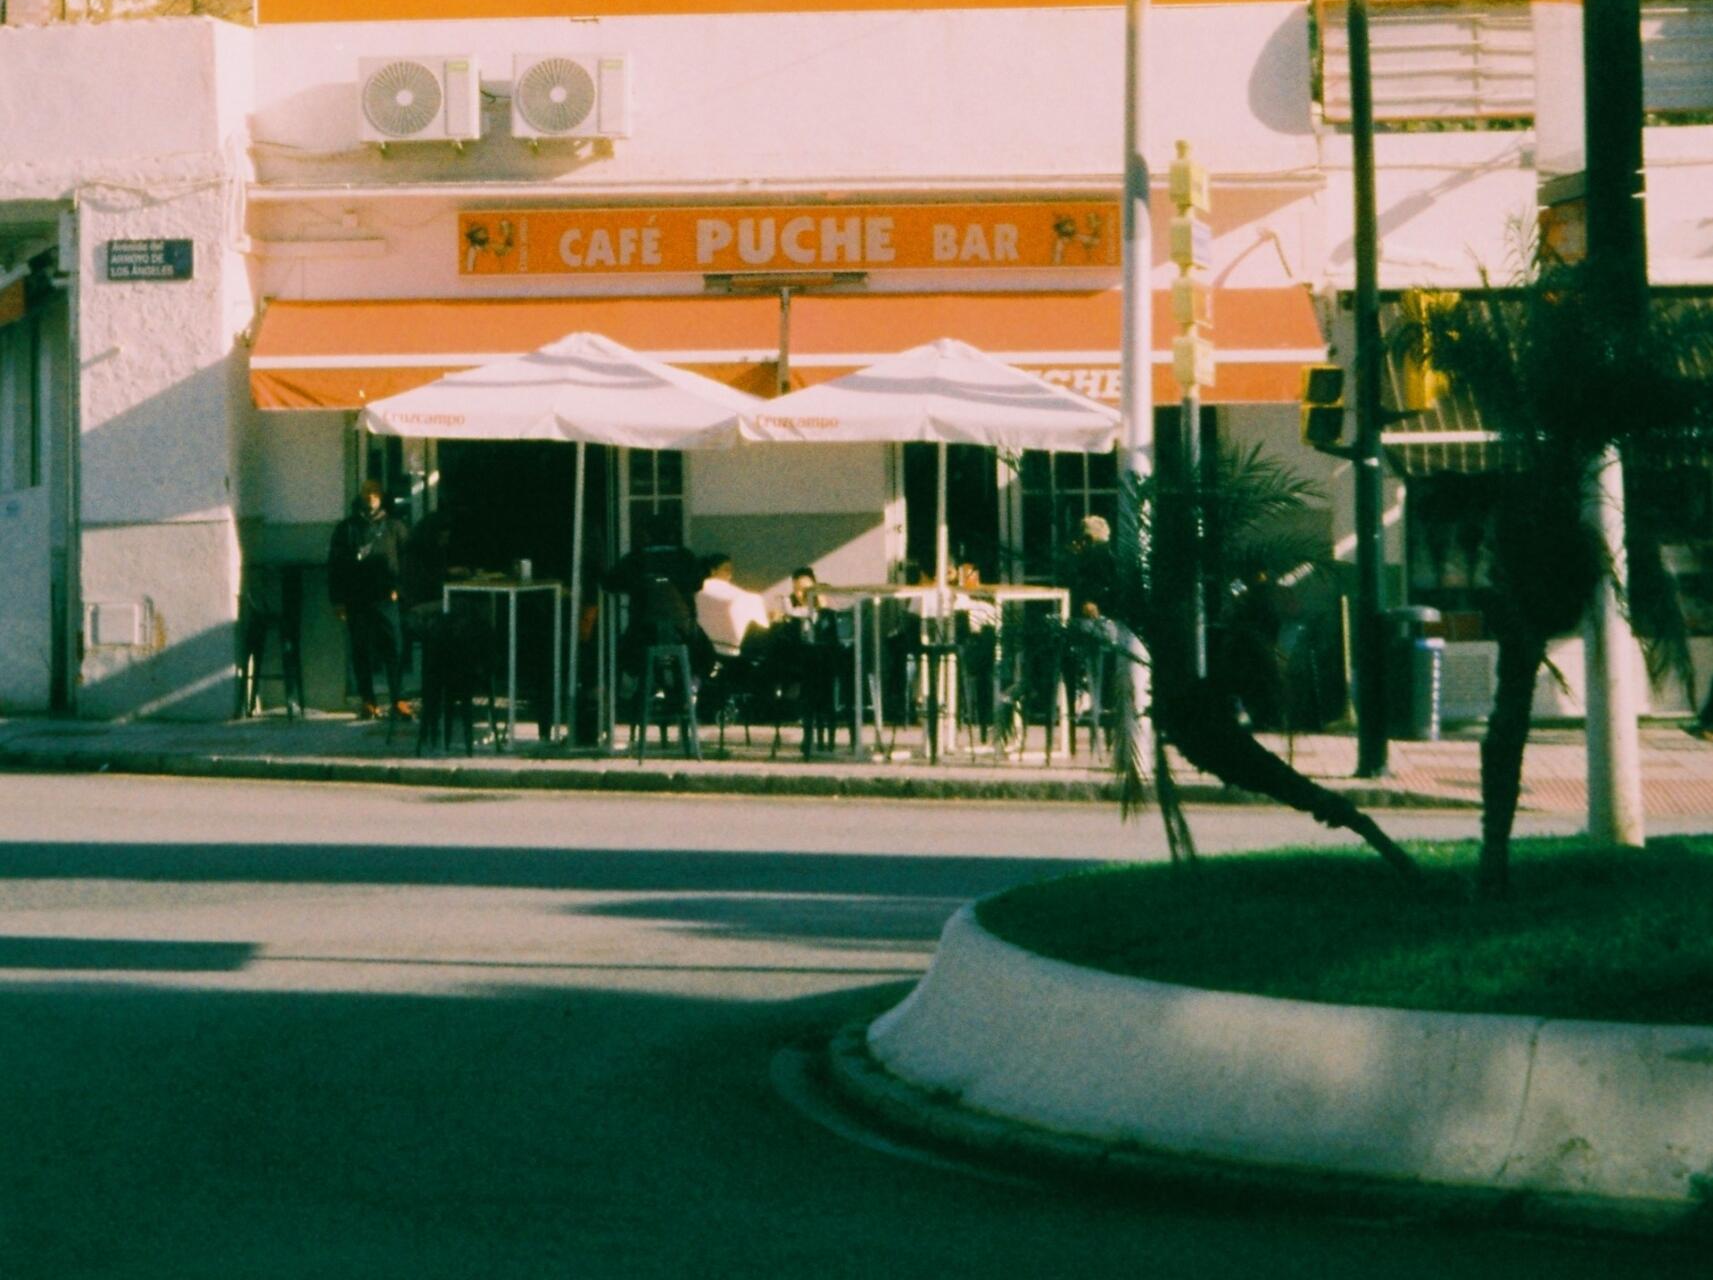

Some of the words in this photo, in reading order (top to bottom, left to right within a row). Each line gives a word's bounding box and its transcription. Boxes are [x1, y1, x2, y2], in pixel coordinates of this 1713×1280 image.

[559, 216, 662, 267] CAFÉ
[696, 216, 896, 265] PUCHE
[933, 223, 1019, 262] BAR
